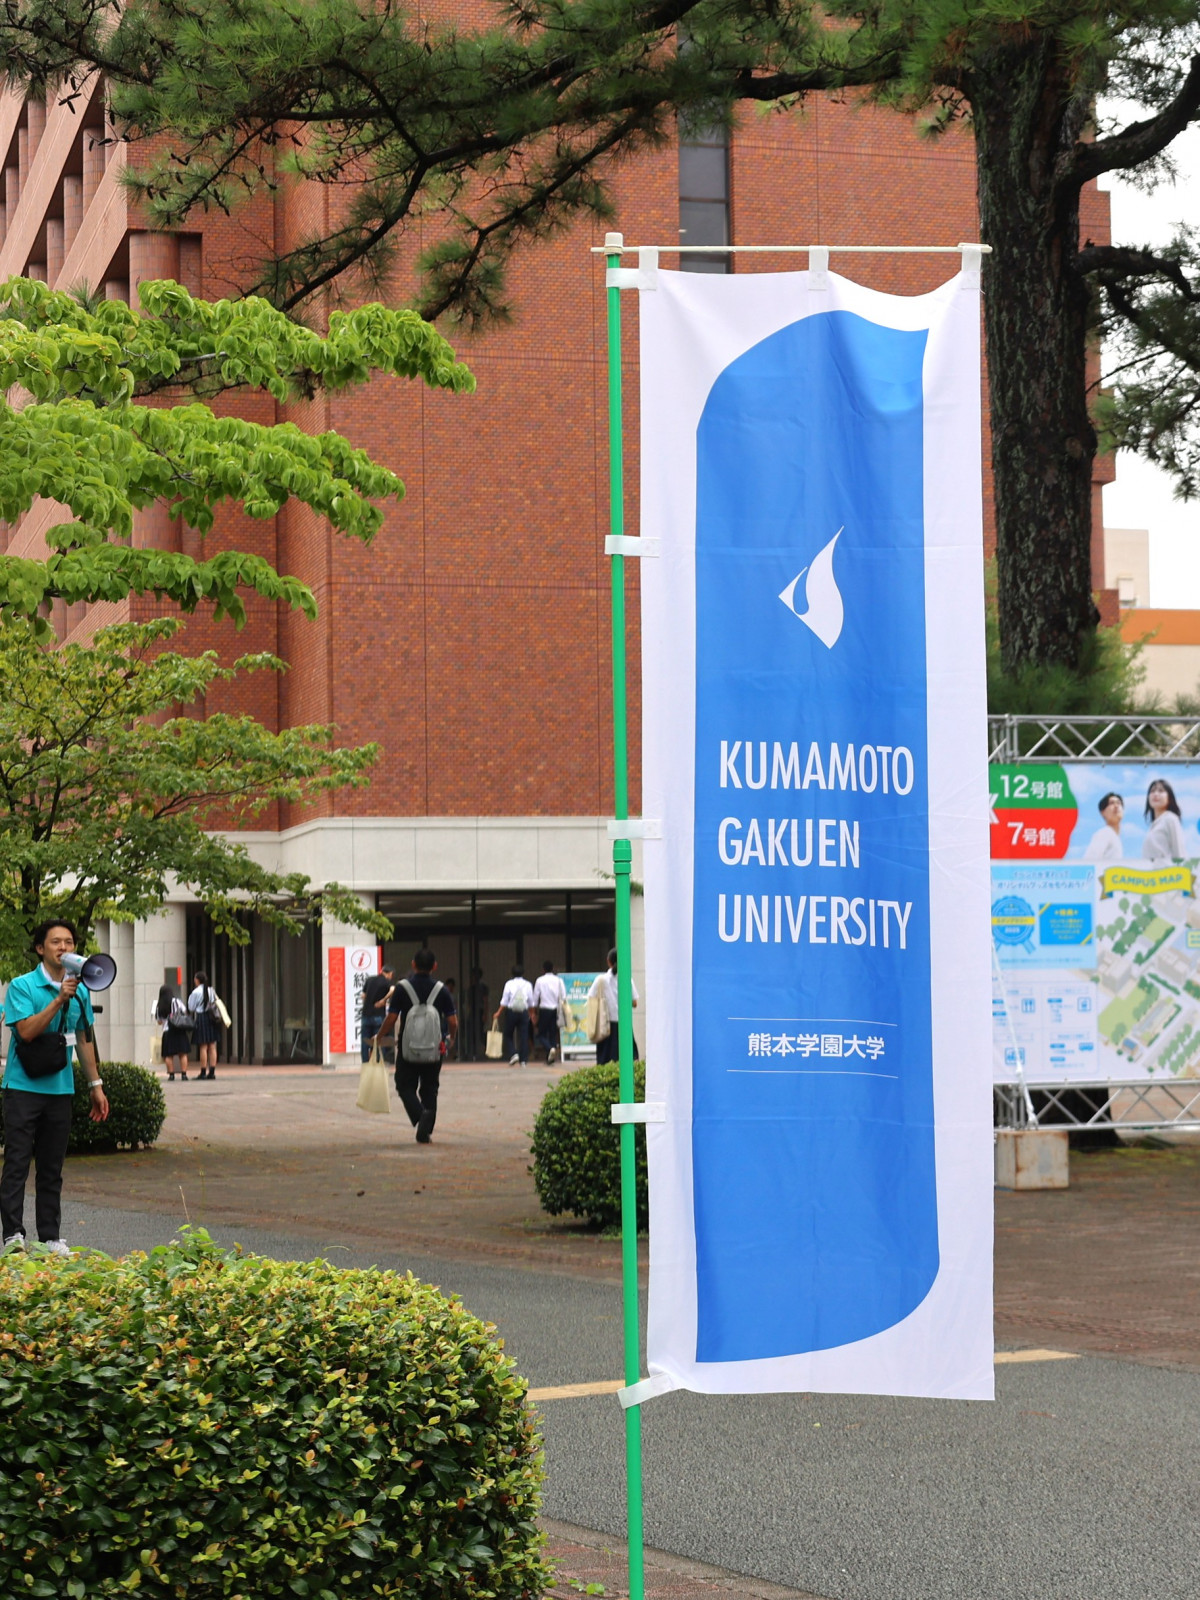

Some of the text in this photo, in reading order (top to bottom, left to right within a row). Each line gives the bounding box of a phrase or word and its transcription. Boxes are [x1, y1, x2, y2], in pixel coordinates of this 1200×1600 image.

[719, 740, 914, 796] KUMAMOTO
[1000, 774, 1063, 799] 12号館
[717, 817, 860, 869] GAKUEN
[1007, 822, 1056, 847] 7号館
[1111, 873, 1183, 888] CAMPUS MAP
[717, 893, 913, 950] UNIVERSITY
[332, 951, 343, 1050] INFORMATION
[747, 1032, 885, 1060] 熊本学園大学
